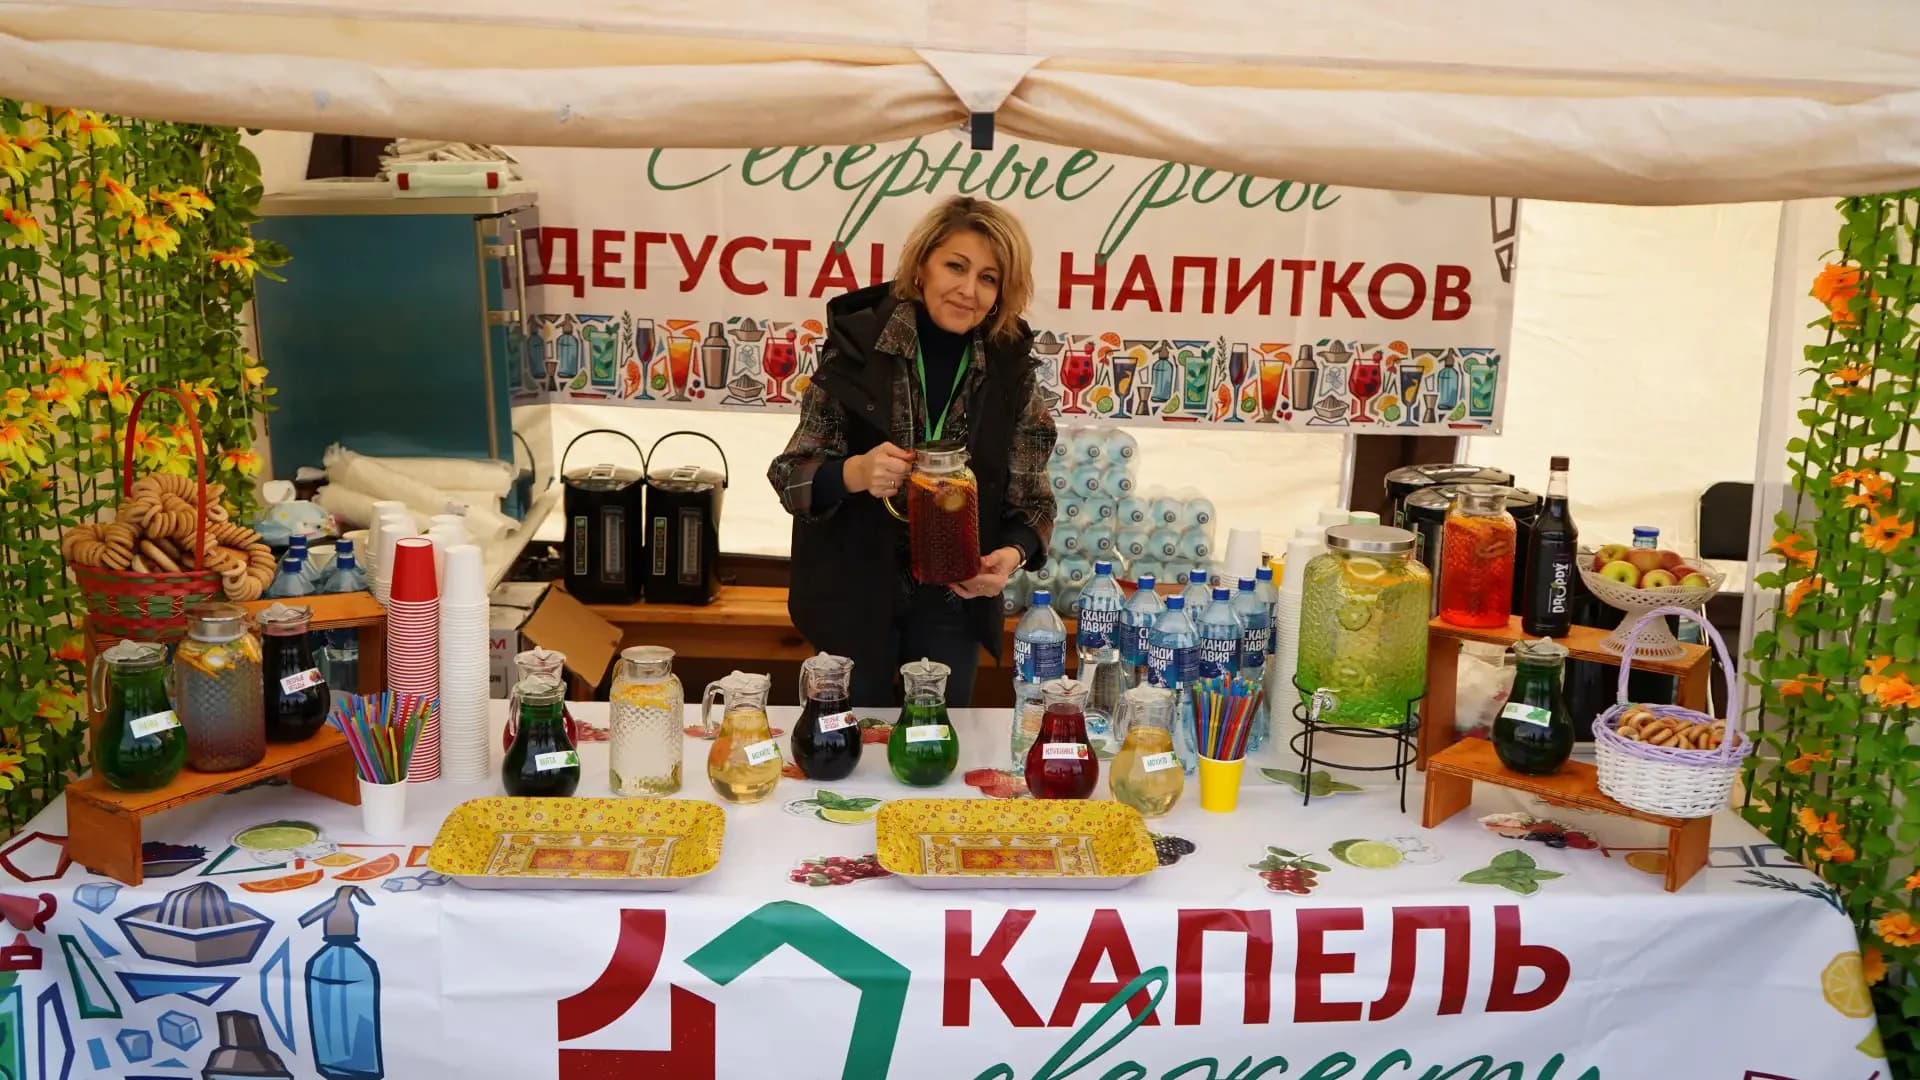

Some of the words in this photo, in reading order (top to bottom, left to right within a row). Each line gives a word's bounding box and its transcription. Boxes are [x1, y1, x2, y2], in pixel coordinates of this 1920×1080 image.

[541, 226, 884, 298] ДЕГУСТА
[1057, 252, 1472, 321] НАПИТКОВ
[1081, 609, 1119, 623] СКАНДИ
[1081, 620, 1113, 633] НАВИЯ
[1201, 638, 1236, 652] КАНДИ
[1201, 650, 1229, 663] АВИЯ
[943, 905, 1571, 1028] КАПЕЛЬ
